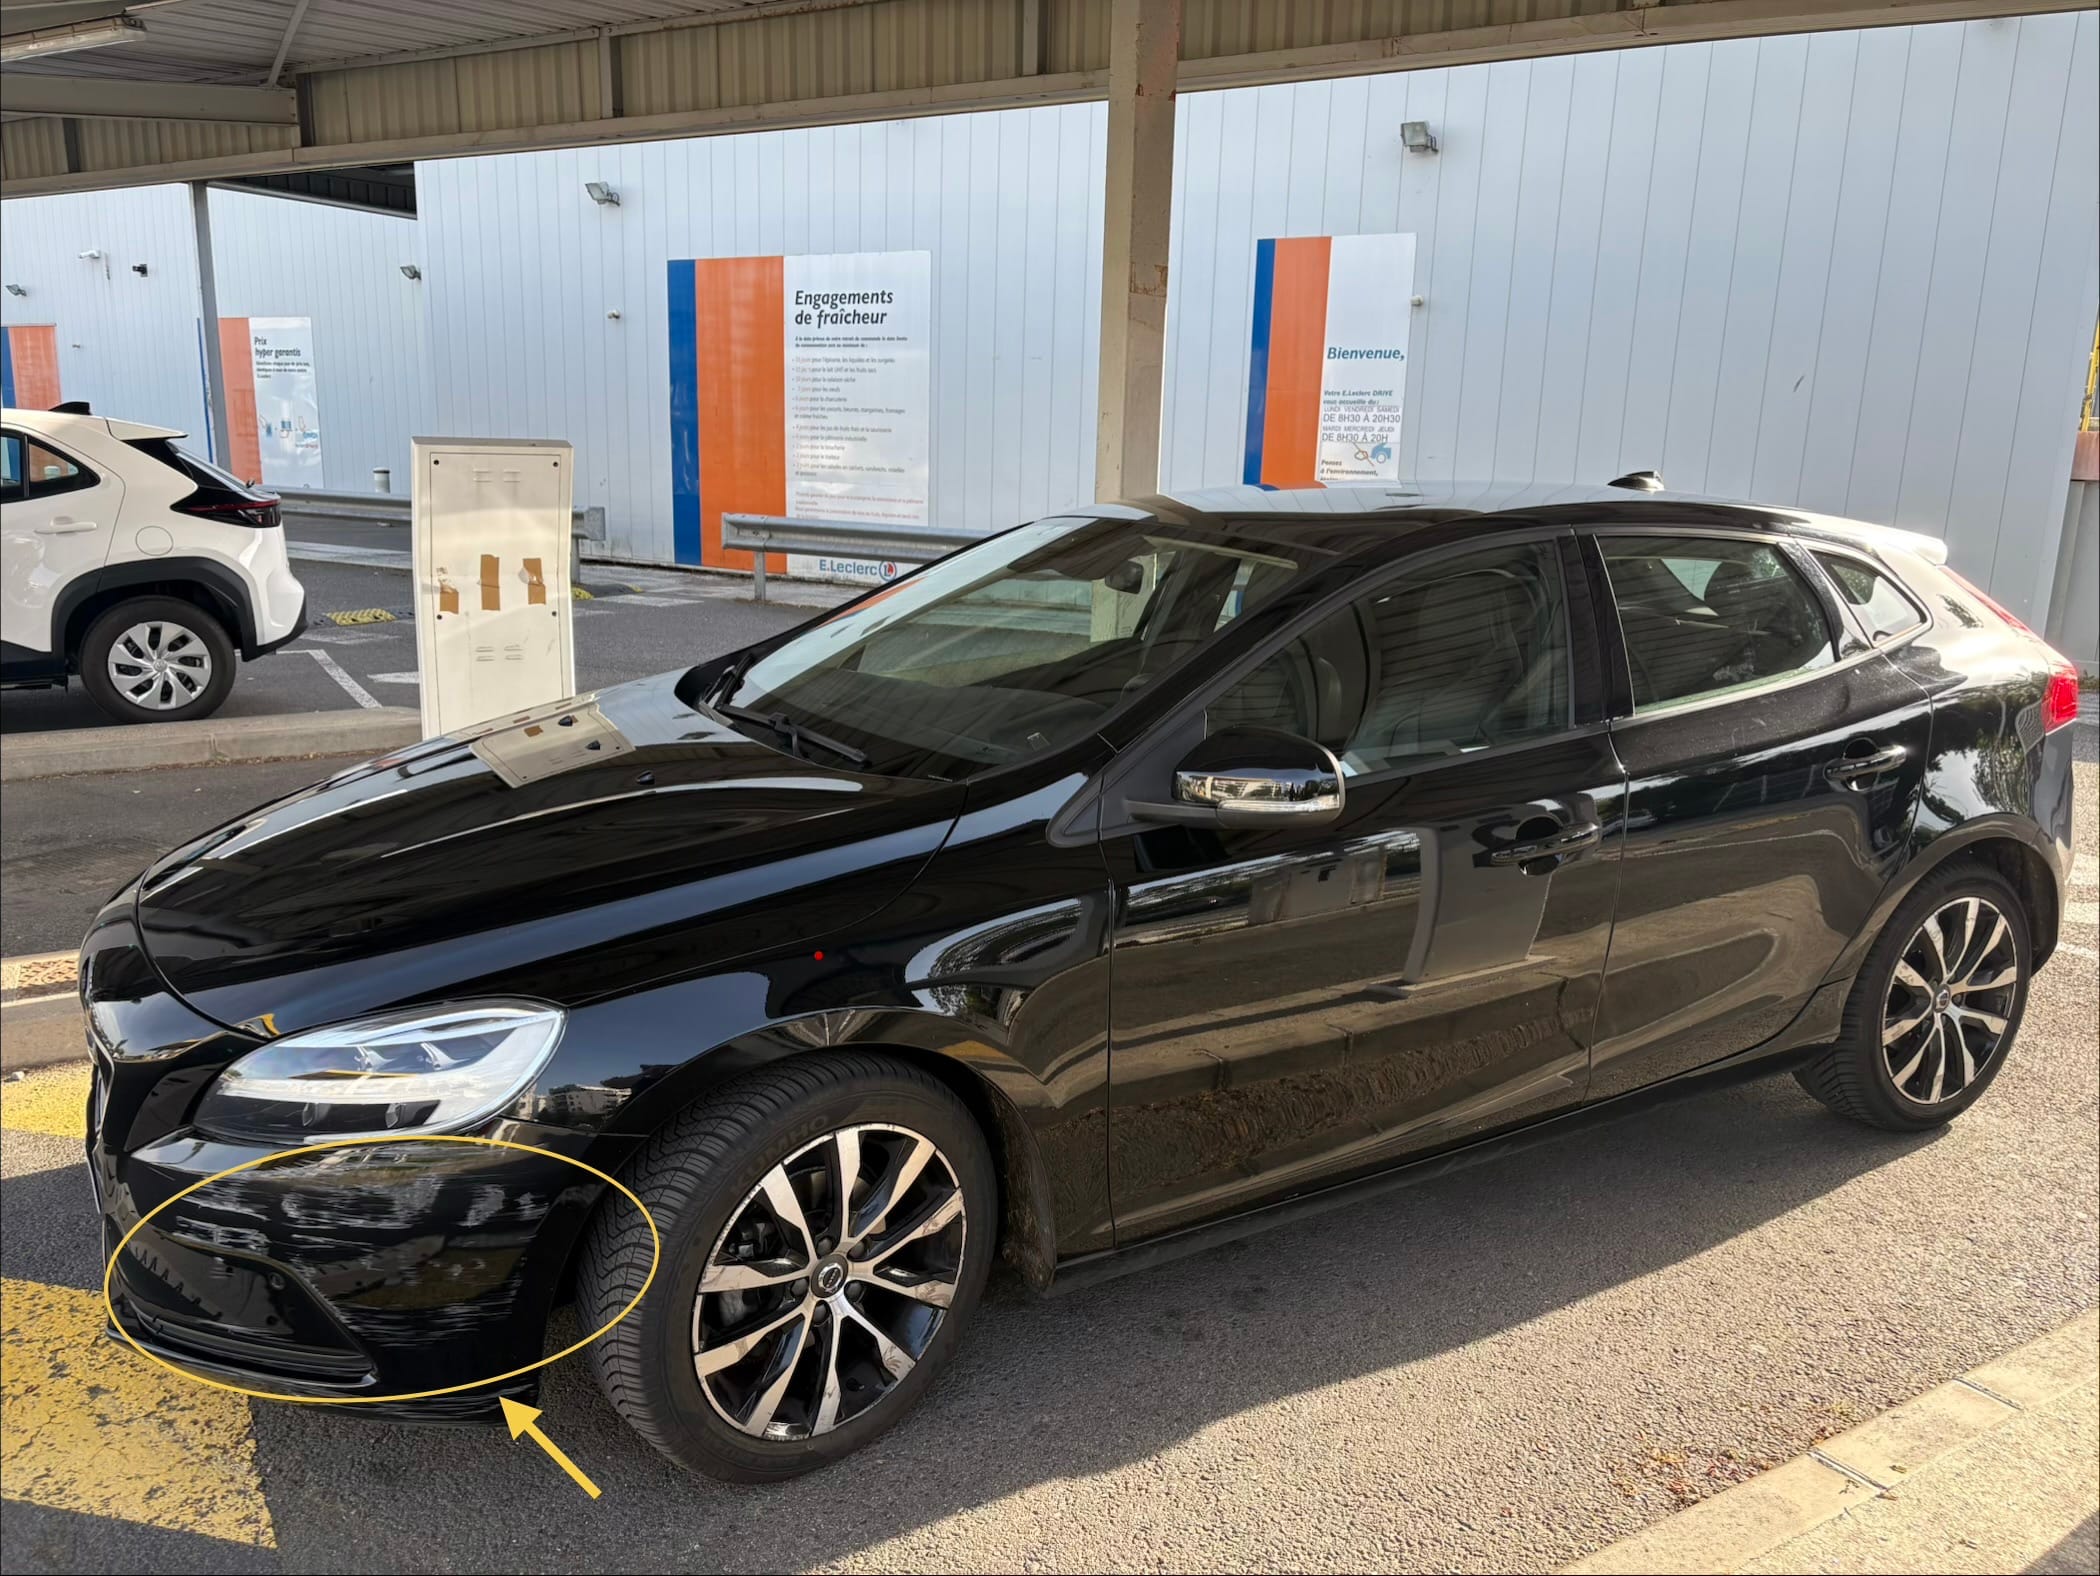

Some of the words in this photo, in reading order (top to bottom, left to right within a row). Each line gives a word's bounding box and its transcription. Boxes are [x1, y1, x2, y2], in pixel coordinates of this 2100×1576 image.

[795, 290, 894, 310] Engagements
[795, 310, 812, 325] de
[817, 308, 887, 328] fraîcheur
[254, 336, 267, 345] Prix
[255, 348, 273, 359] hyper
[275, 348, 301, 359] garantis
[1327, 347, 1405, 361] Bienvenue,
[1323, 413, 1336, 422] DE
[1338, 413, 1361, 422] 8H30
[1372, 414, 1401, 423] 20H30
[1322, 432, 1335, 441] DE
[1371, 434, 1388, 442] 20H
[819, 559, 877, 576] E.Leclerc
